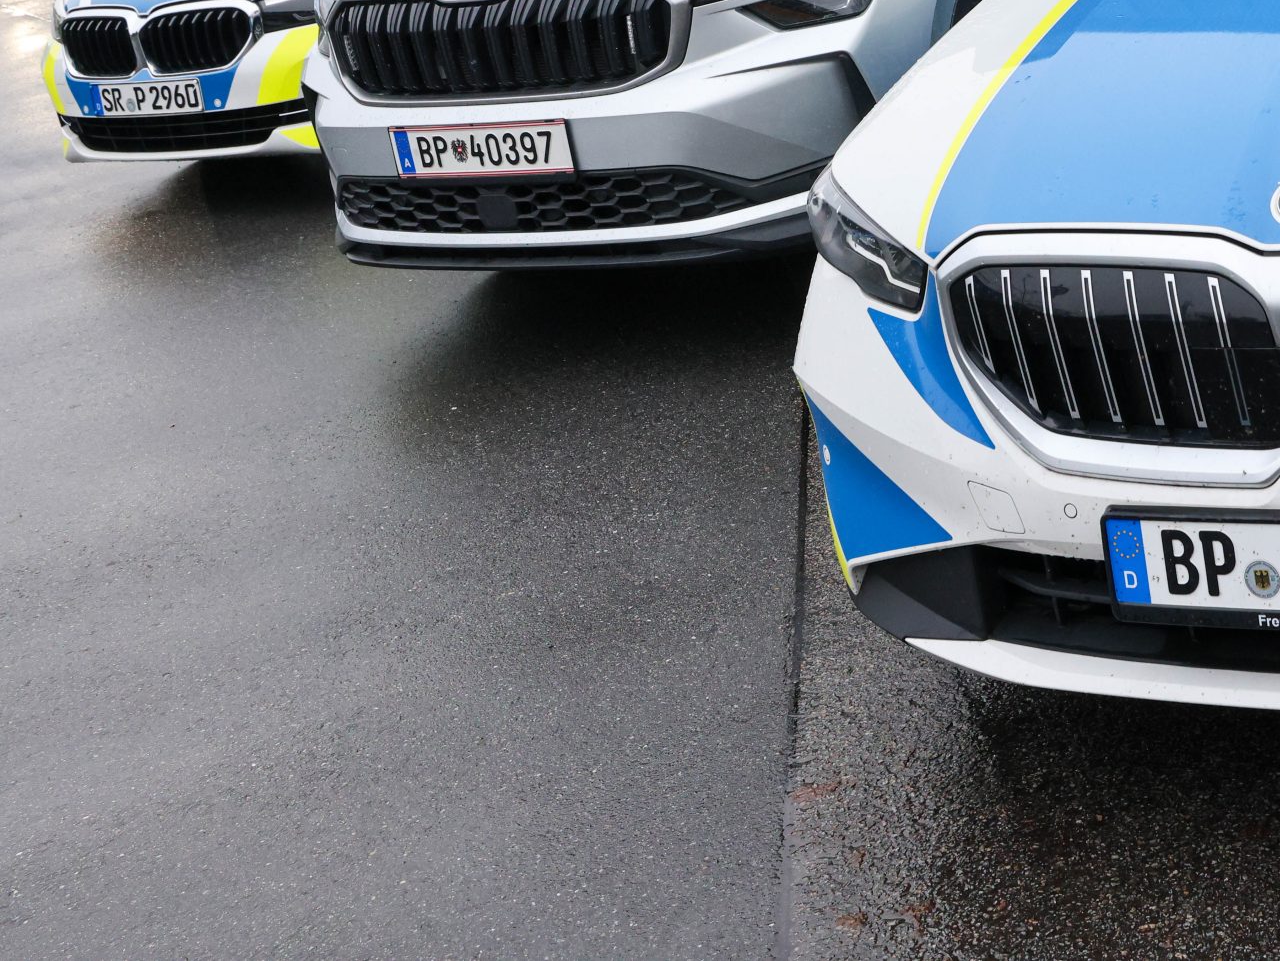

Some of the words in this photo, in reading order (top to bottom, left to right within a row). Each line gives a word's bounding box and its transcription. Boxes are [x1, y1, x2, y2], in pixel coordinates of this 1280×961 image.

[101, 88, 126, 112] SR
[133, 86, 146, 111] P
[149, 83, 199, 111] 2960
[404, 157, 412, 168] A
[416, 135, 448, 168] BP
[470, 130, 552, 167] 40397
[1161, 529, 1237, 597] BP
[1123, 570, 1138, 589] D
